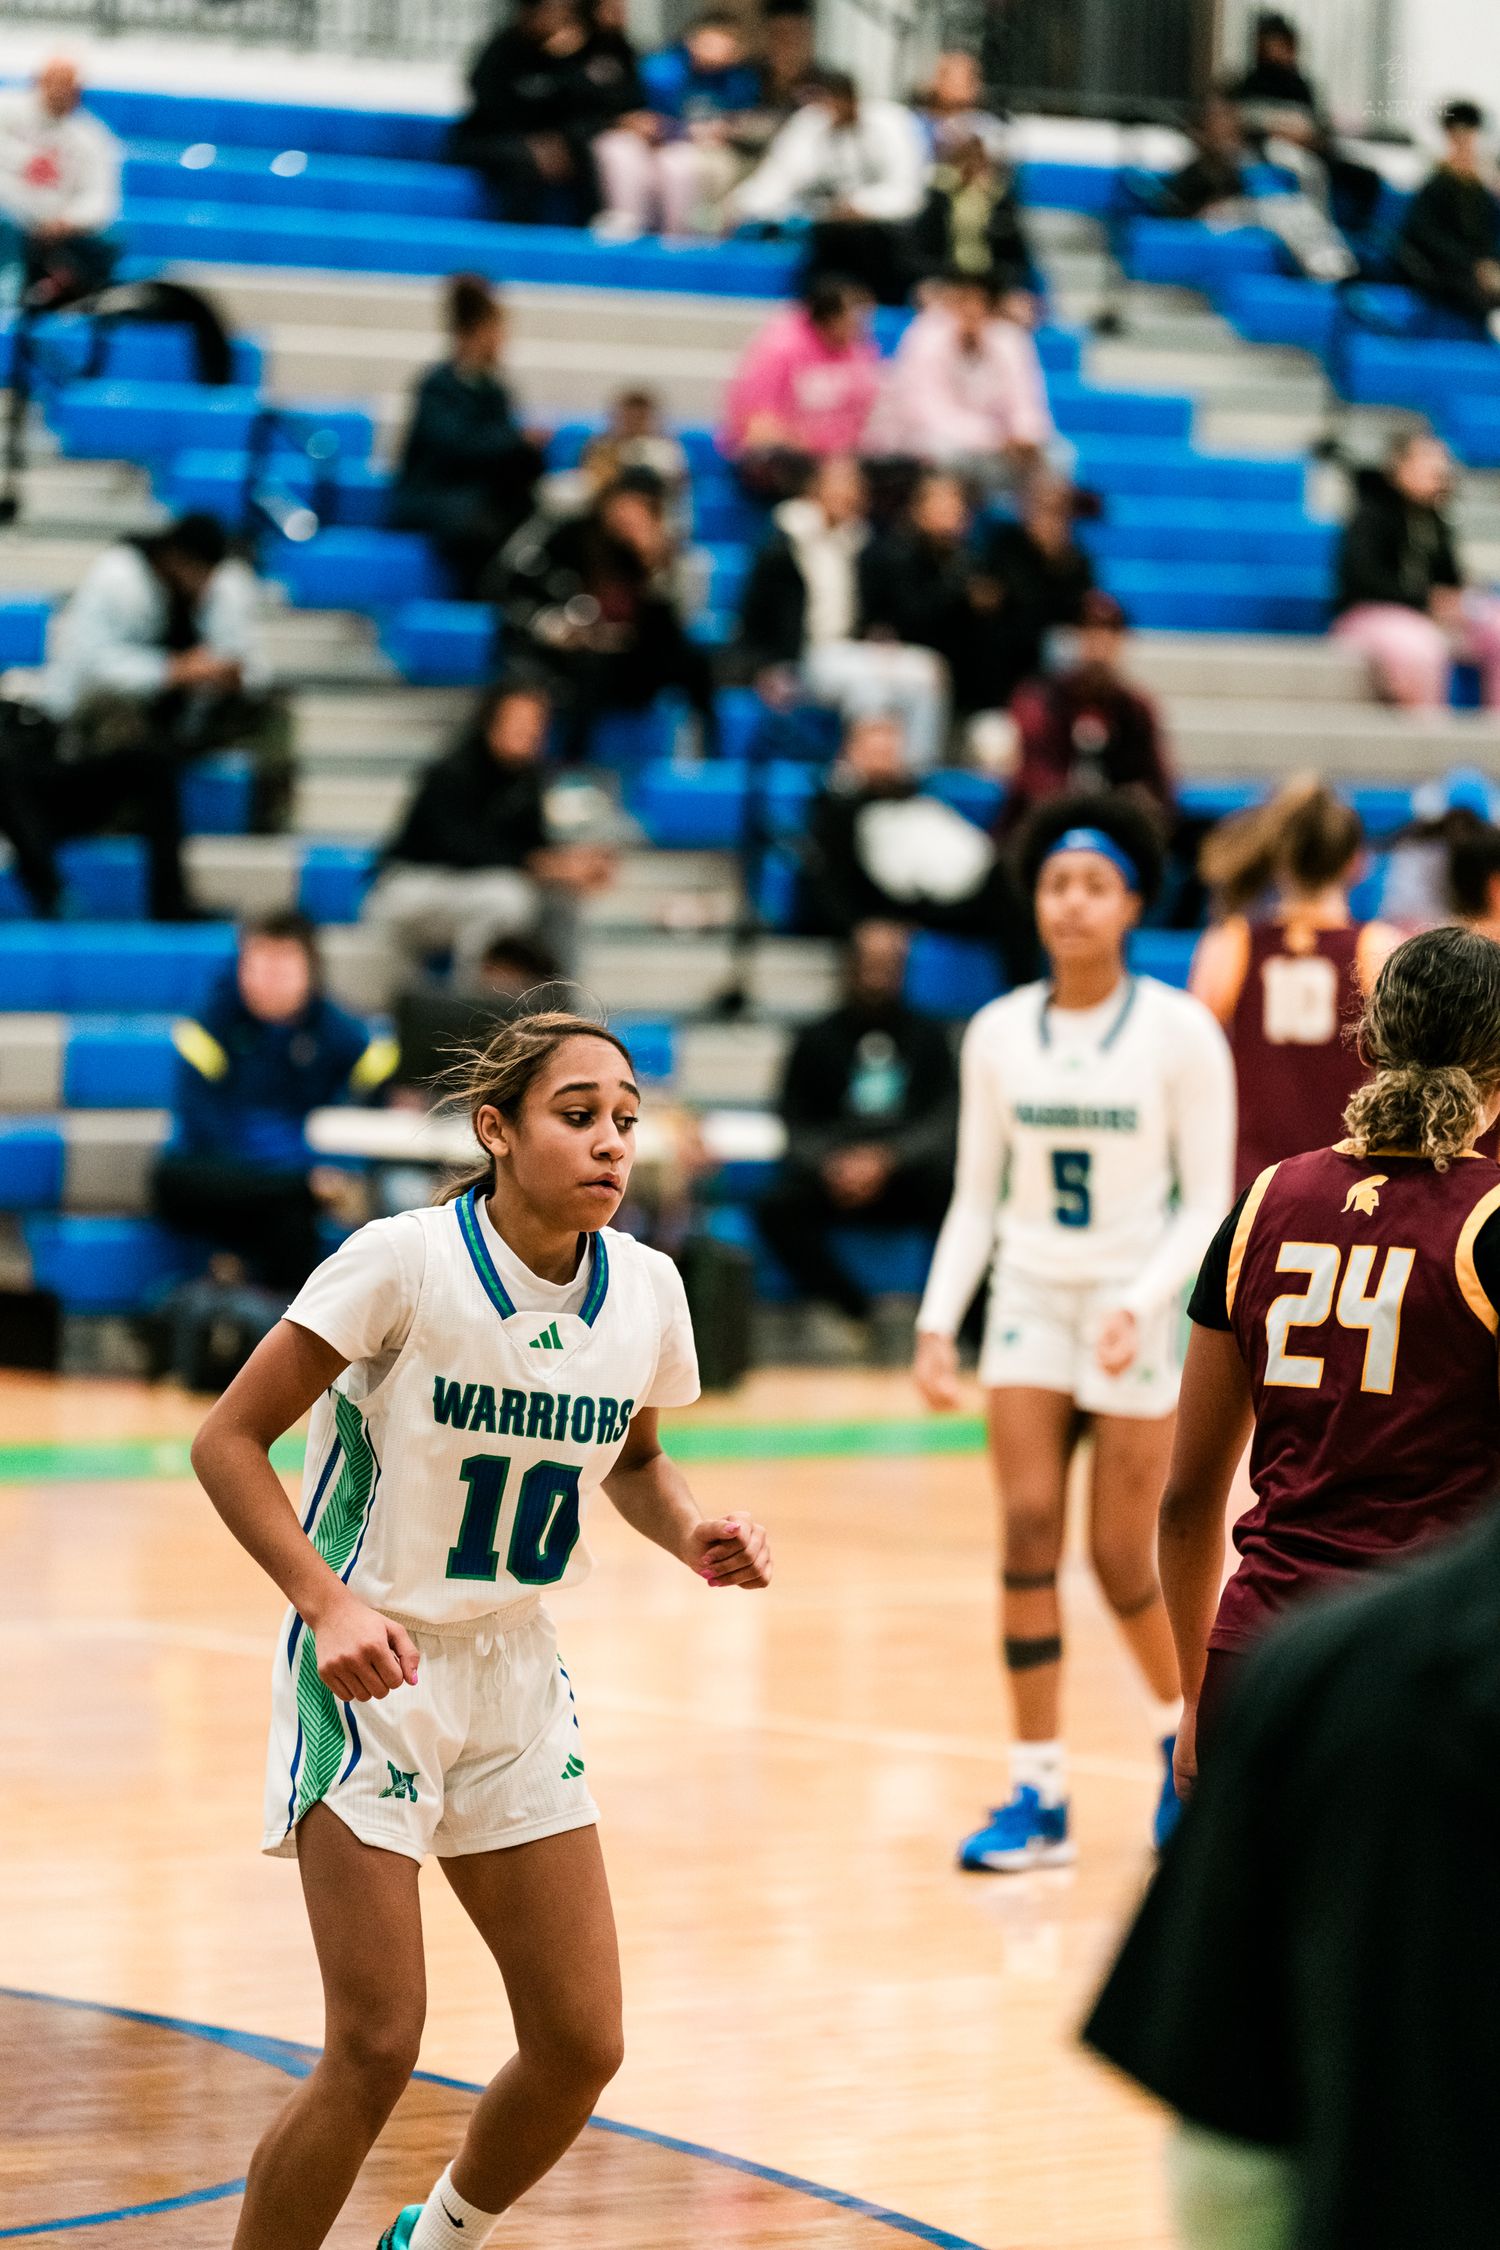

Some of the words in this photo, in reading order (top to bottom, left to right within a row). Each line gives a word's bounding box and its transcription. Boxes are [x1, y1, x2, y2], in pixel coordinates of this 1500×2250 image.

[1051, 1149, 1091, 1229] 5
[1263, 1241, 1416, 1395] 24
[432, 1375, 635, 1445] WARRIORS
[445, 1453, 584, 1585] 10
